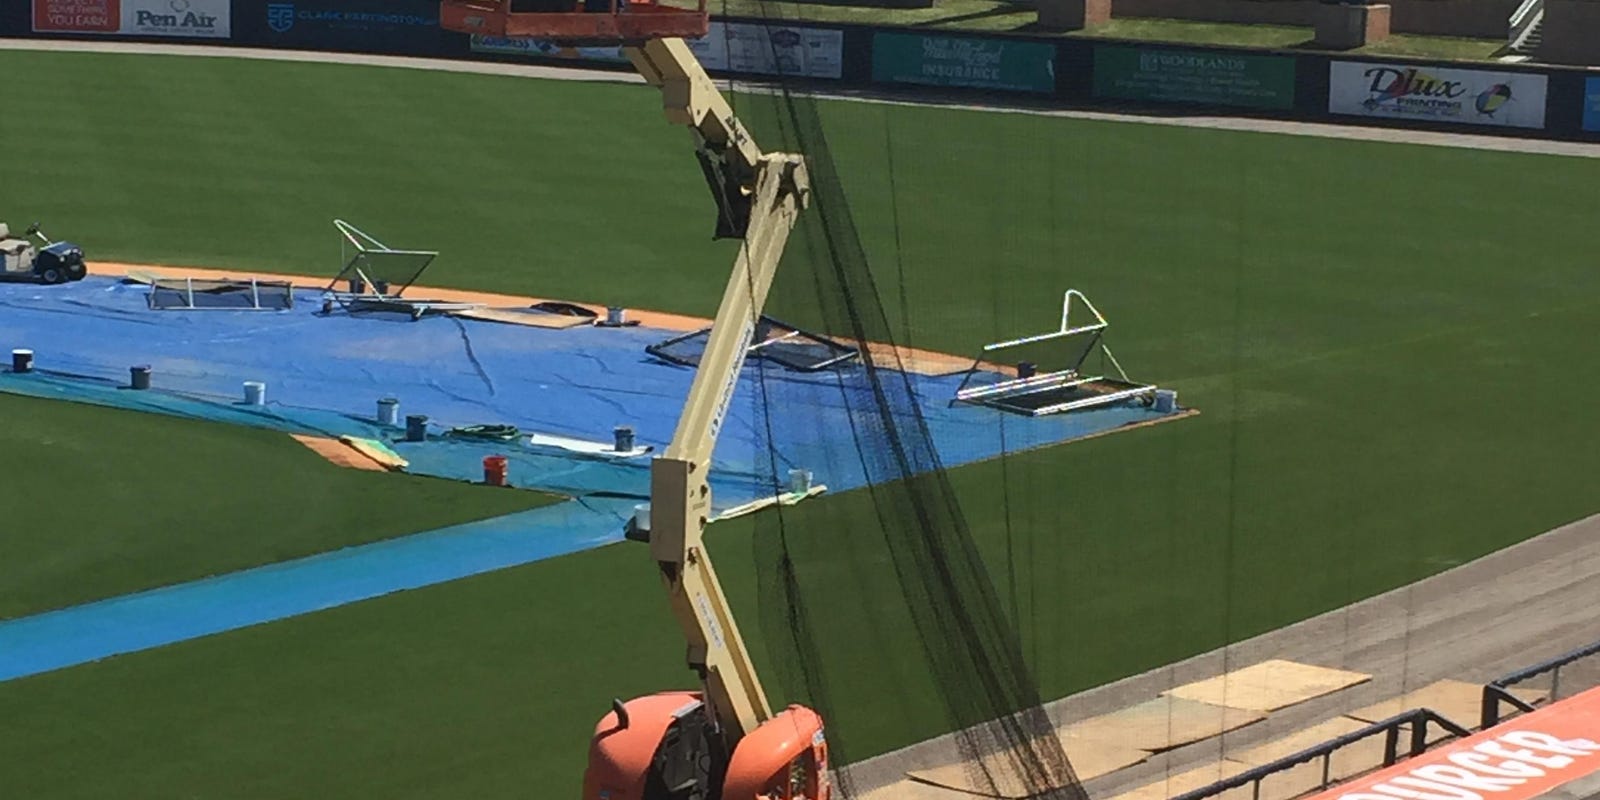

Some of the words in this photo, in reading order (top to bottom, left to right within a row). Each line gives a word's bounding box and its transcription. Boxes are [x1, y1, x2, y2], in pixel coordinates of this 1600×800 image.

[47, 14, 74, 25] YOU
[75, 15, 108, 26] EARN
[136, 10, 177, 27] Pen
[180, 11, 217, 28] Air
[1160, 54, 1247, 71] WOODLANDS
[921, 63, 1000, 80] INSURANCE
[1364, 67, 1467, 99] Dlux
[1396, 97, 1462, 109] PRINTING
[1334, 730, 1600, 800] URGER
